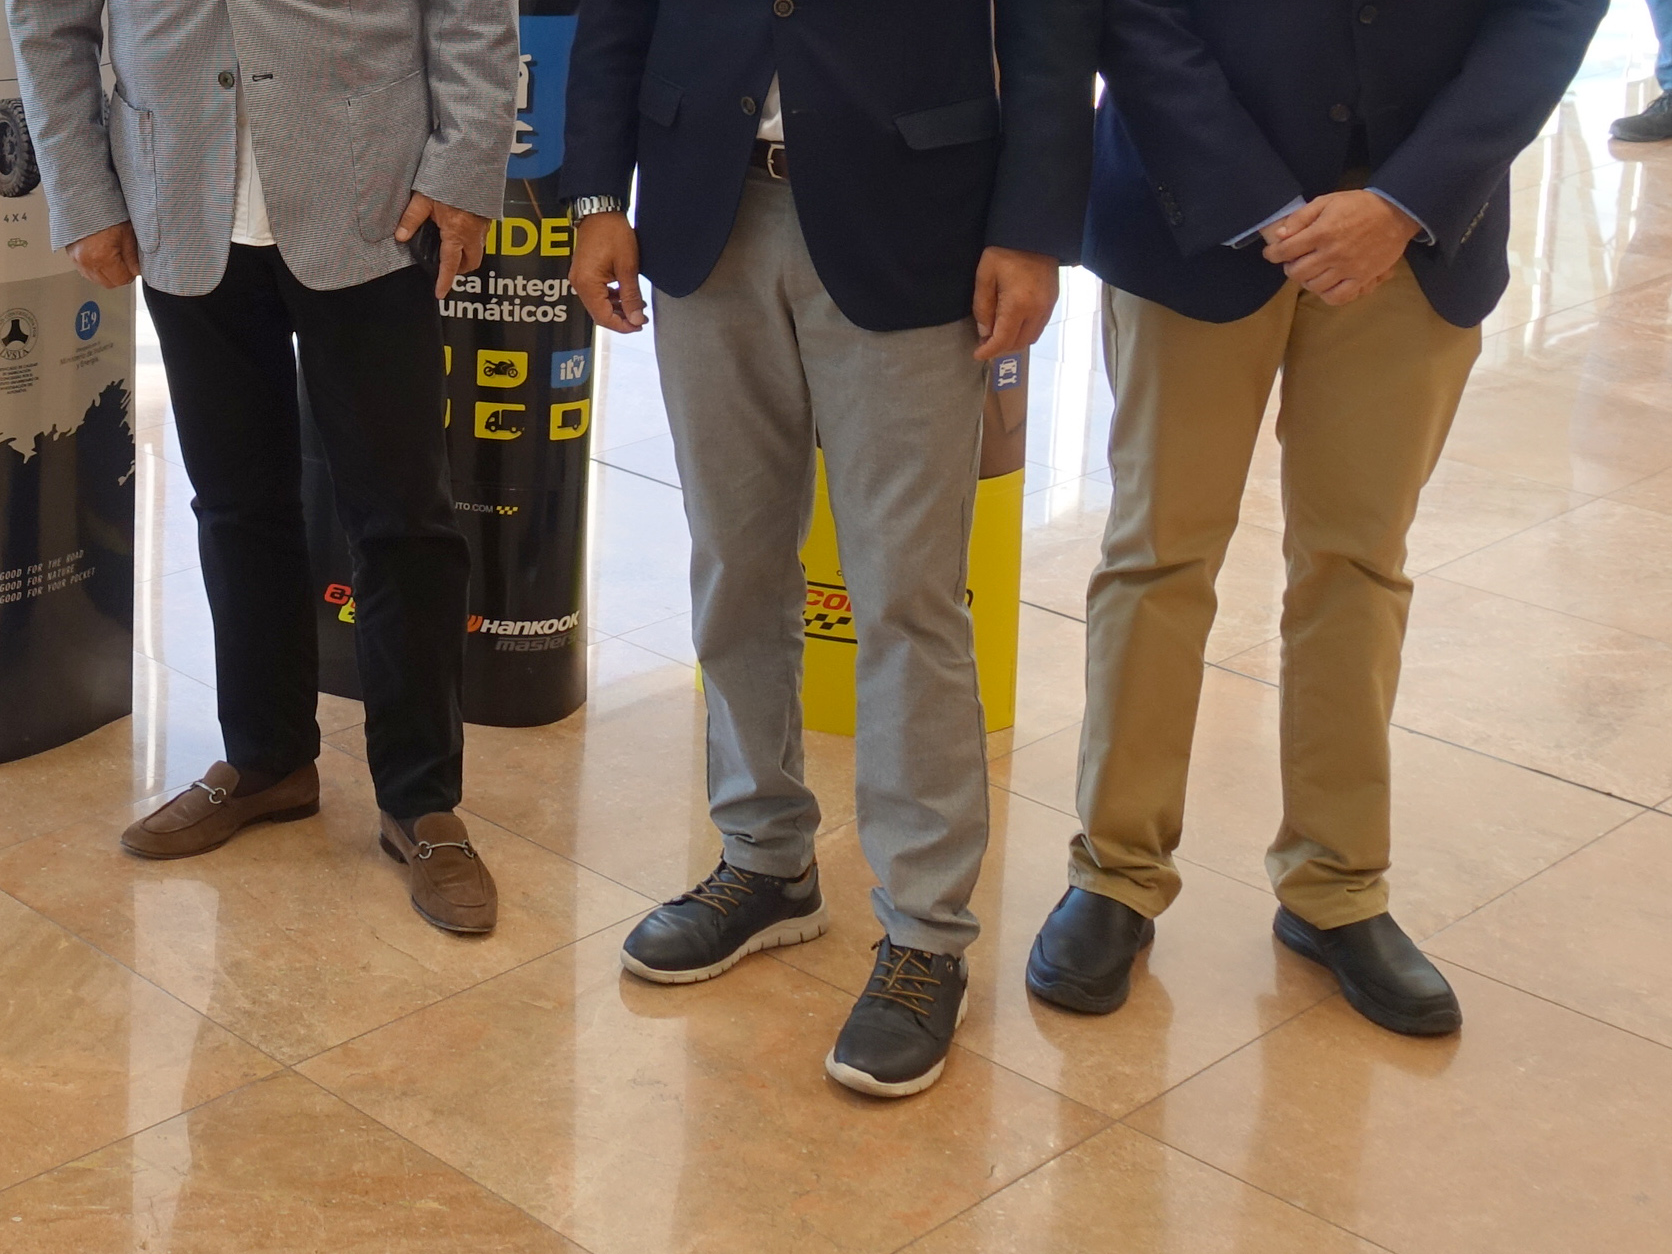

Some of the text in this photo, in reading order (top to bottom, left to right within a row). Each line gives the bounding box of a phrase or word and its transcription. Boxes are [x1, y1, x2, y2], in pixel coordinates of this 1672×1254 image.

[3, 212, 28, 223] 4 X 4
[0, 568, 22, 581] GOOD
[27, 563, 43, 575] FOR
[0, 564, 75, 593] GOOD FOR NATURE
[0, 567, 96, 604] GOOD FOR YOUR POCKET
